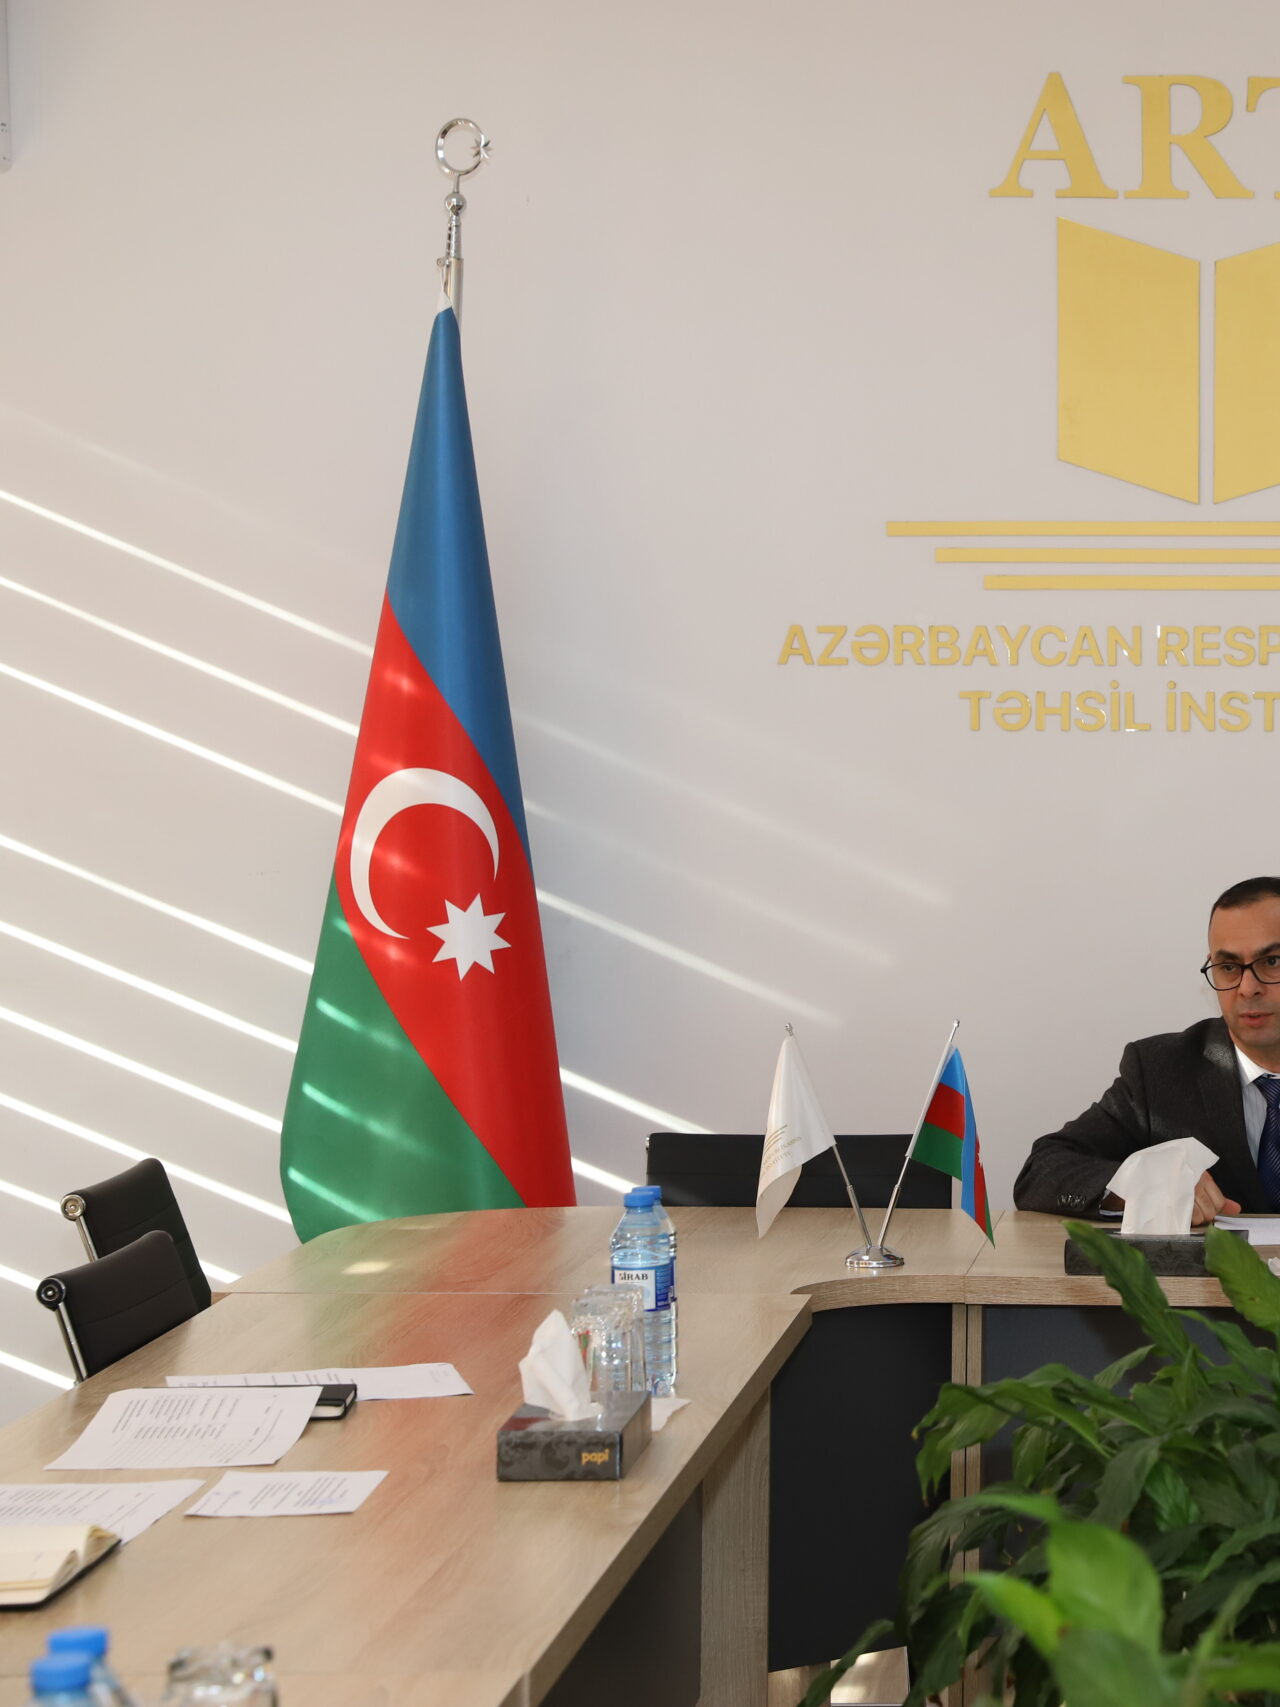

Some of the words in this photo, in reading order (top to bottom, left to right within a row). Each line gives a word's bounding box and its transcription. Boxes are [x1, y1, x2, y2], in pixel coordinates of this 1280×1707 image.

[777, 624, 1143, 667] AZƏRBAYCAN
[959, 680, 1152, 733] TƏHSİL
[581, 1447, 610, 1466] papi
